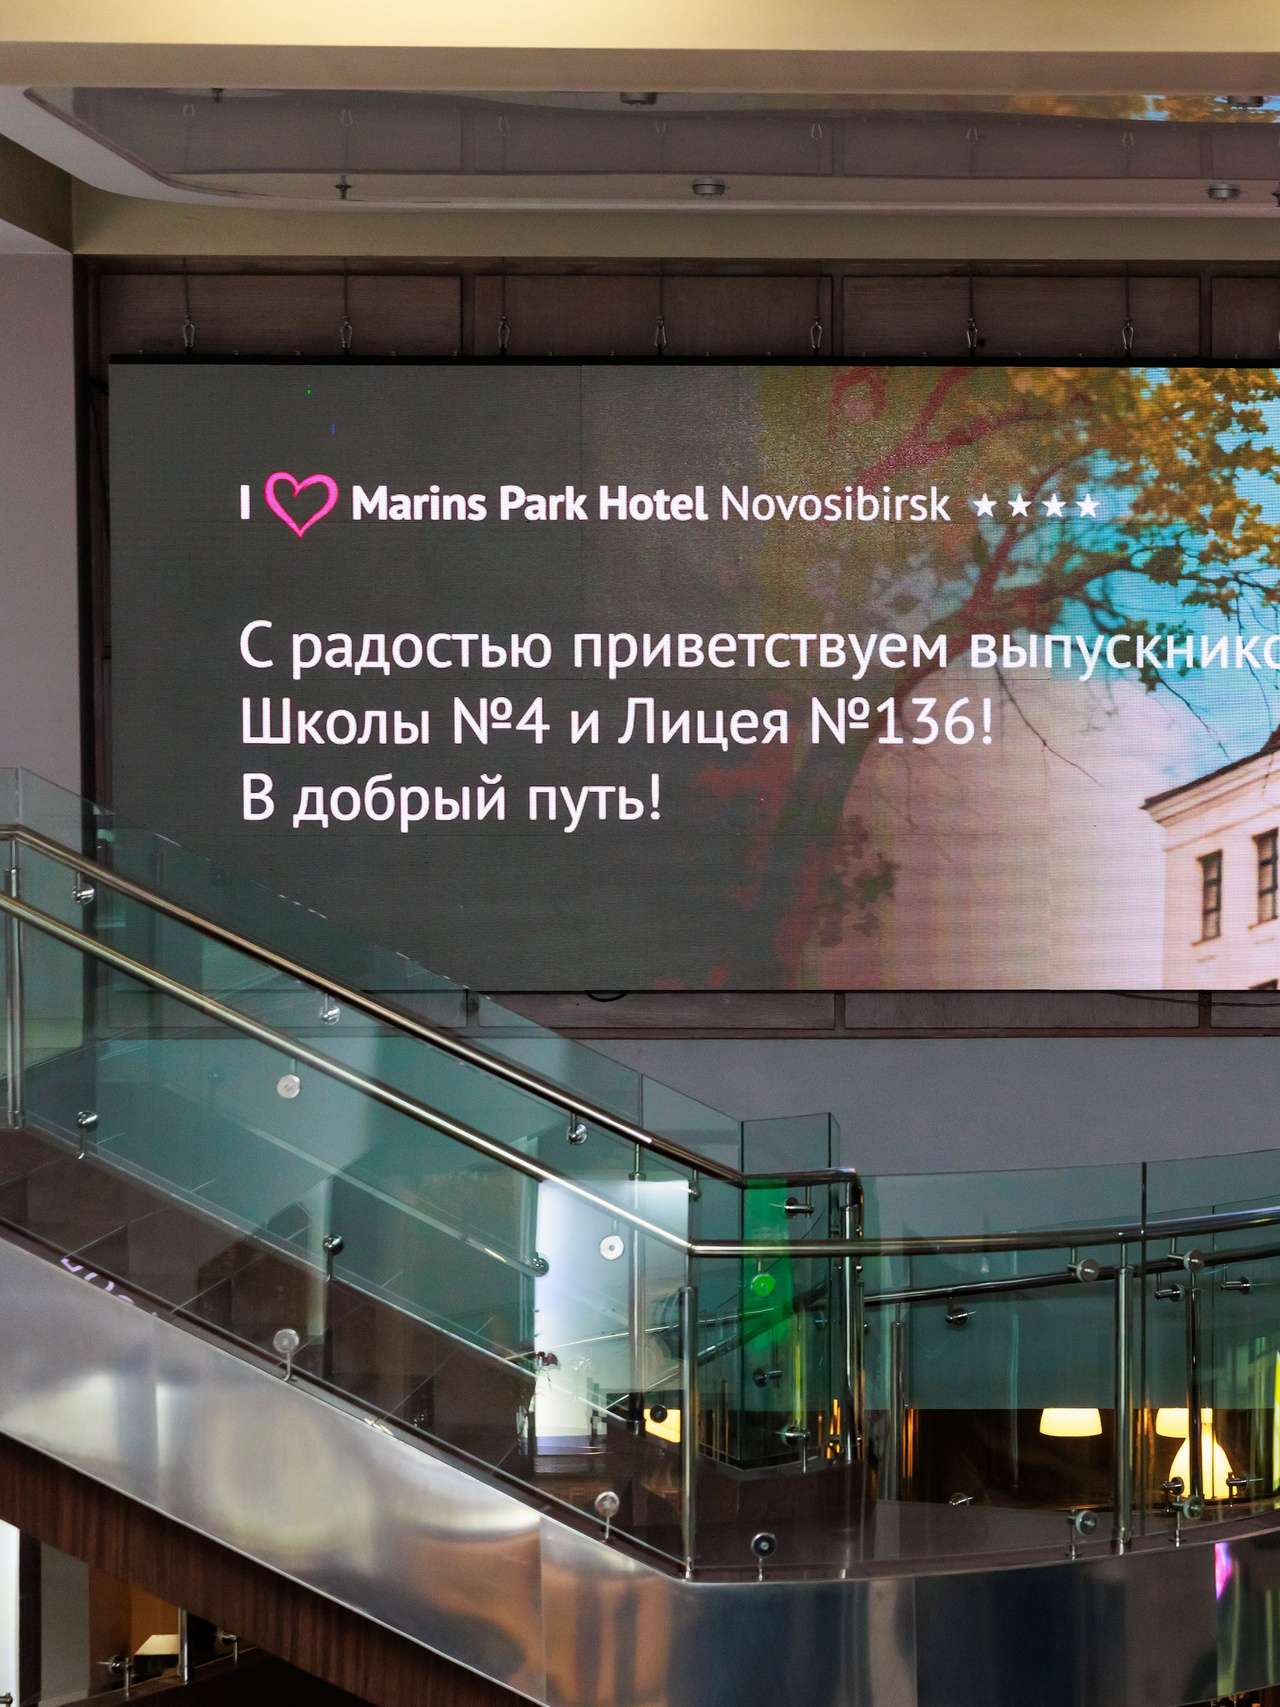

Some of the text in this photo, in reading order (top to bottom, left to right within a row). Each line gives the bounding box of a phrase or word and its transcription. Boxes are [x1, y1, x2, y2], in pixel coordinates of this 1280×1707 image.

[240, 484, 951, 522] I Marins Park Hotel Novosibirsk
[239, 619, 274, 669] С
[292, 632, 552, 681] радостью
[574, 632, 947, 681] приветствуем
[242, 696, 993, 752] Школы №4 и Лицея №136!
[243, 773, 661, 833] В добрый путь!
